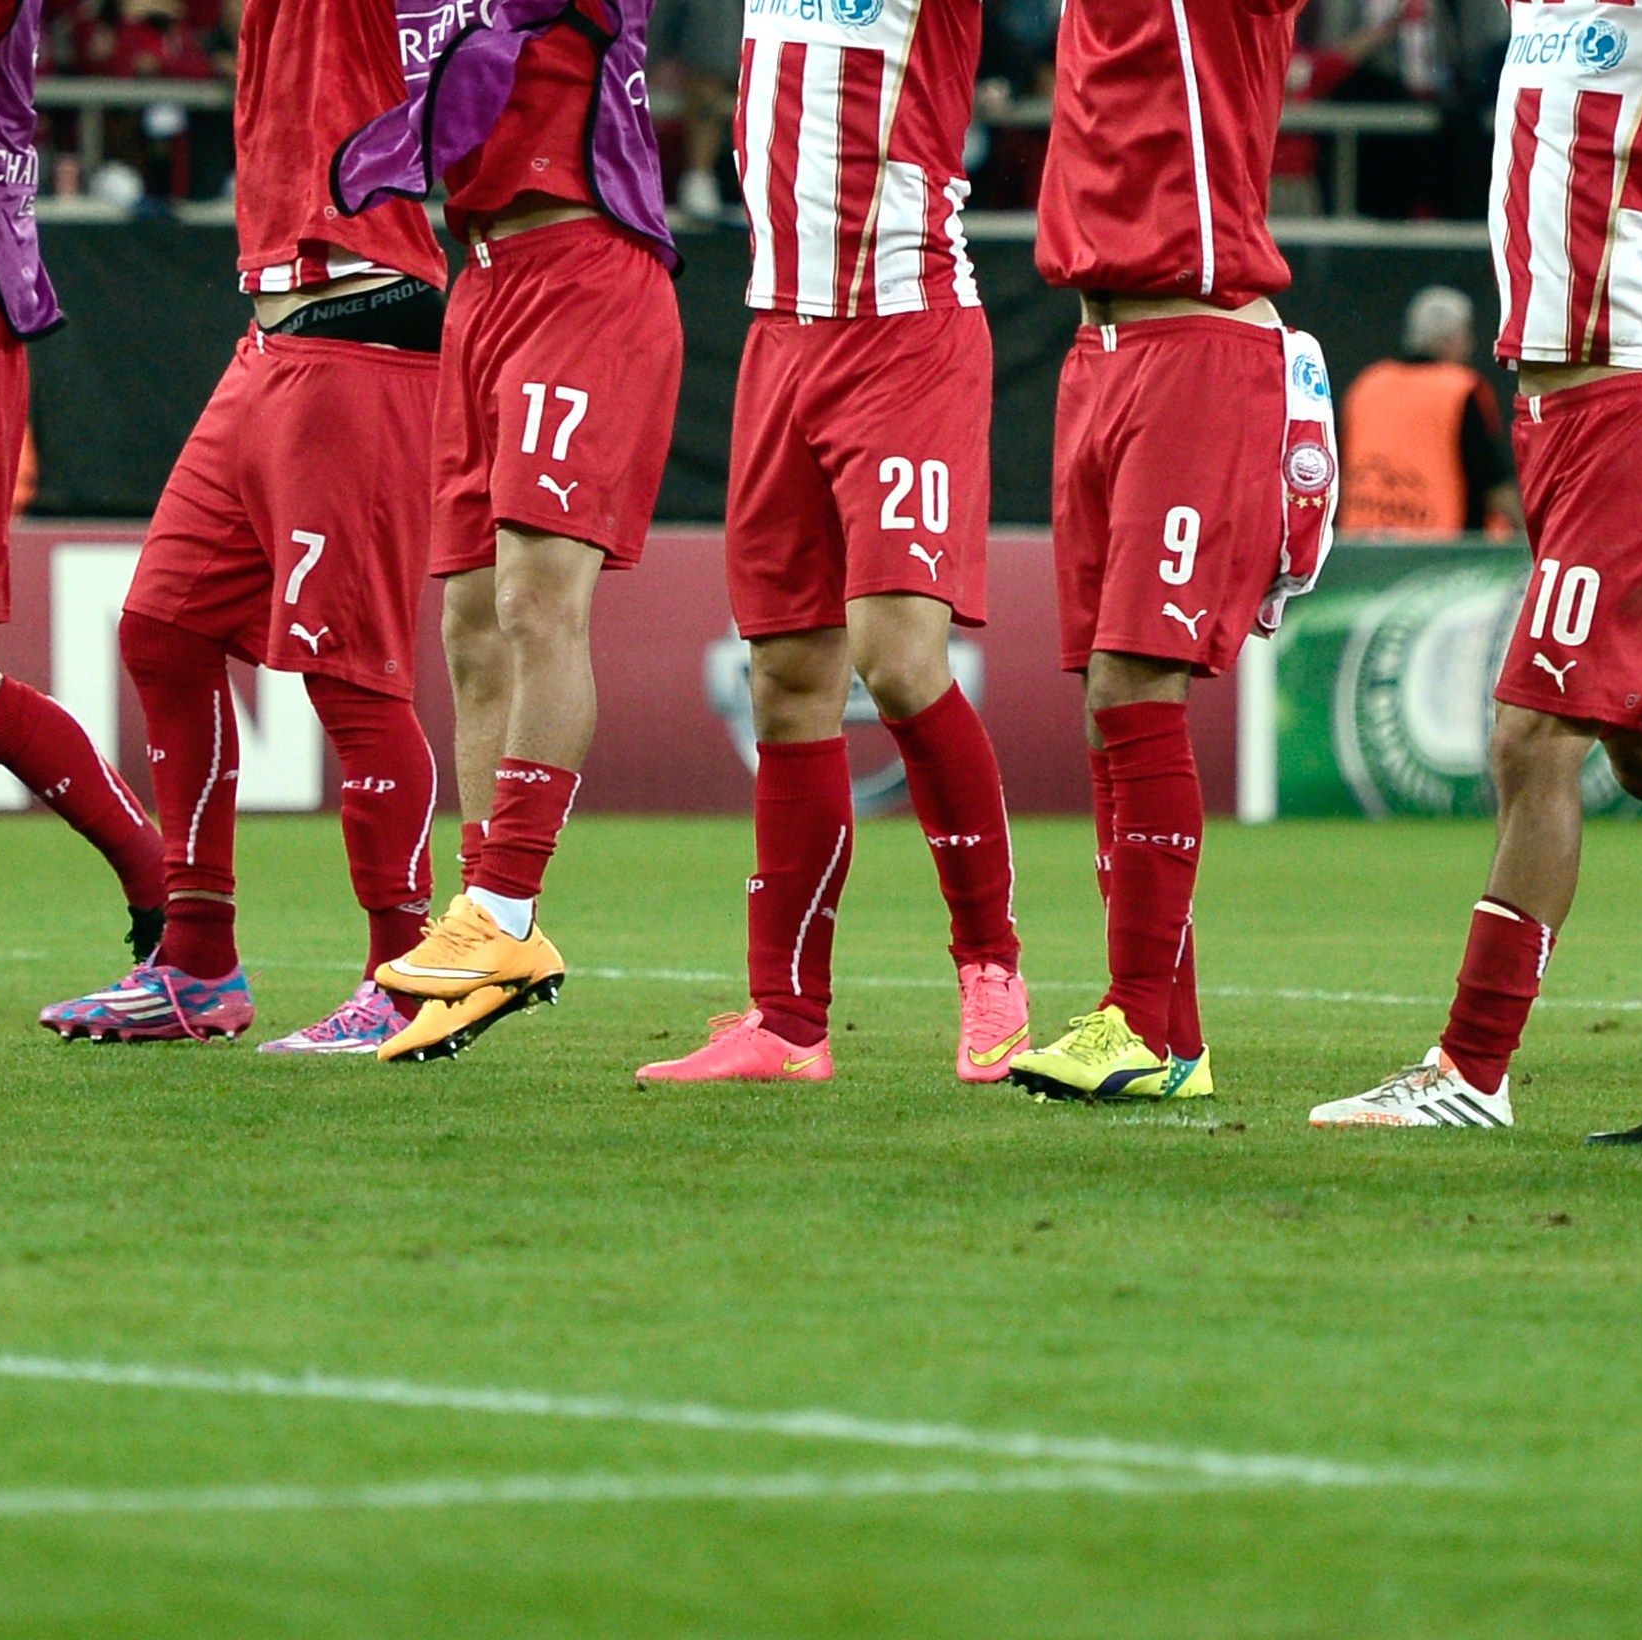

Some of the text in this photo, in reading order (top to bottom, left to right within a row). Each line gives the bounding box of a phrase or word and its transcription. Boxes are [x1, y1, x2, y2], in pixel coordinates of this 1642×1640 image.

[1506, 20, 1580, 64] nicef
[312, 296, 366, 323] NIKE
[522, 382, 589, 461] 17
[879, 456, 950, 534] 20
[284, 529, 326, 606] 7
[1159, 505, 1201, 585] 9
[1529, 558, 1601, 646] 10
